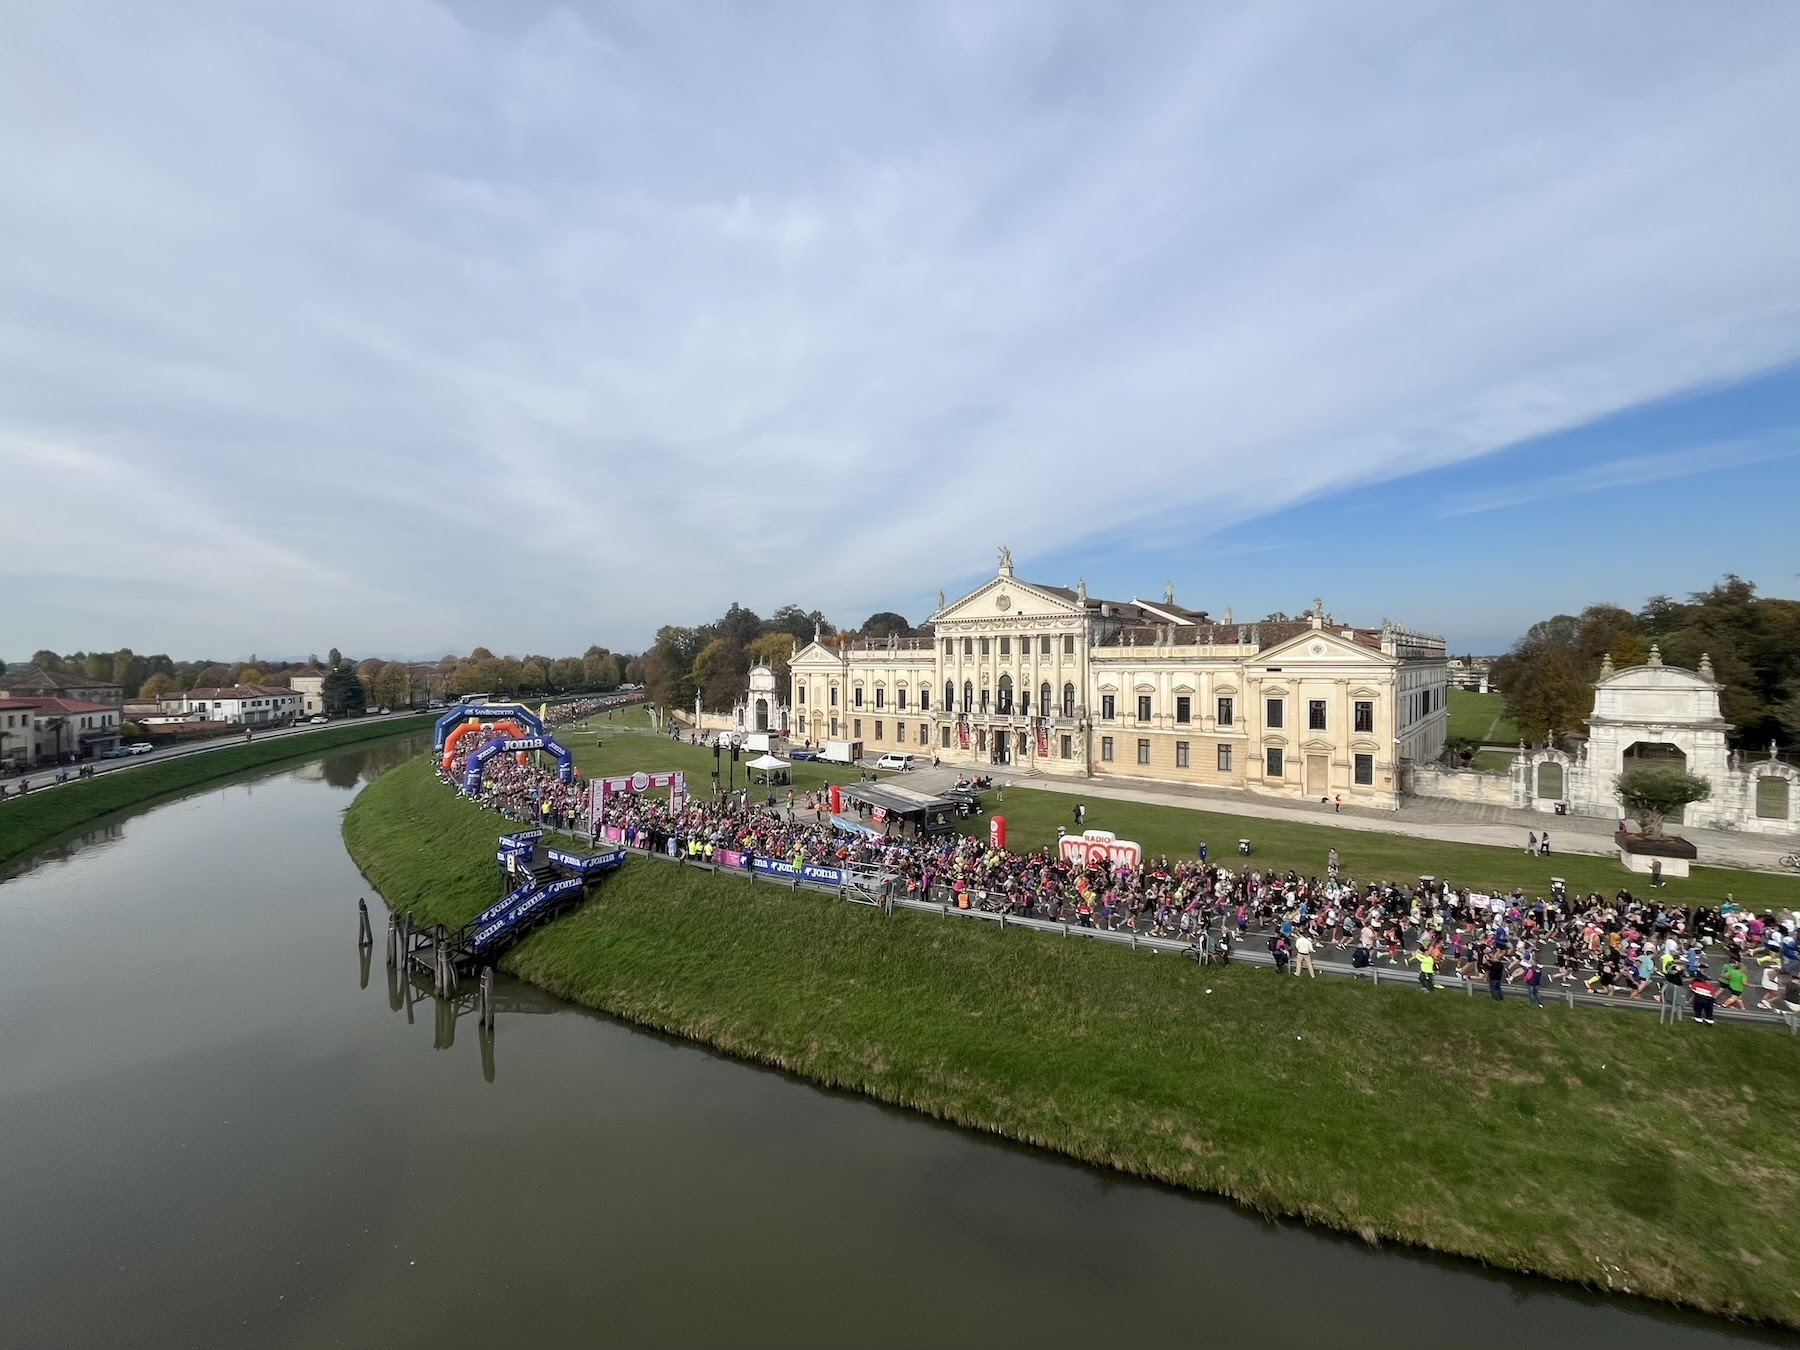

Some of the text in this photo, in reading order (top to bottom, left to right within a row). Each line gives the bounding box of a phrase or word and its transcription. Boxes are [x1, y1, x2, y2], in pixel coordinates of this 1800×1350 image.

[502, 738, 544, 751] Joma
[477, 745, 497, 760] Joma
[518, 830, 543, 840] Joma
[1085, 835, 1111, 844] RADIO
[589, 853, 615, 867] Joma
[753, 858, 768, 868] ma
[811, 867, 838, 879] Joma
[474, 920, 506, 945] Joma
[517, 892, 546, 916] Joma
[554, 877, 582, 892] Joma
[489, 893, 519, 917] Joma
